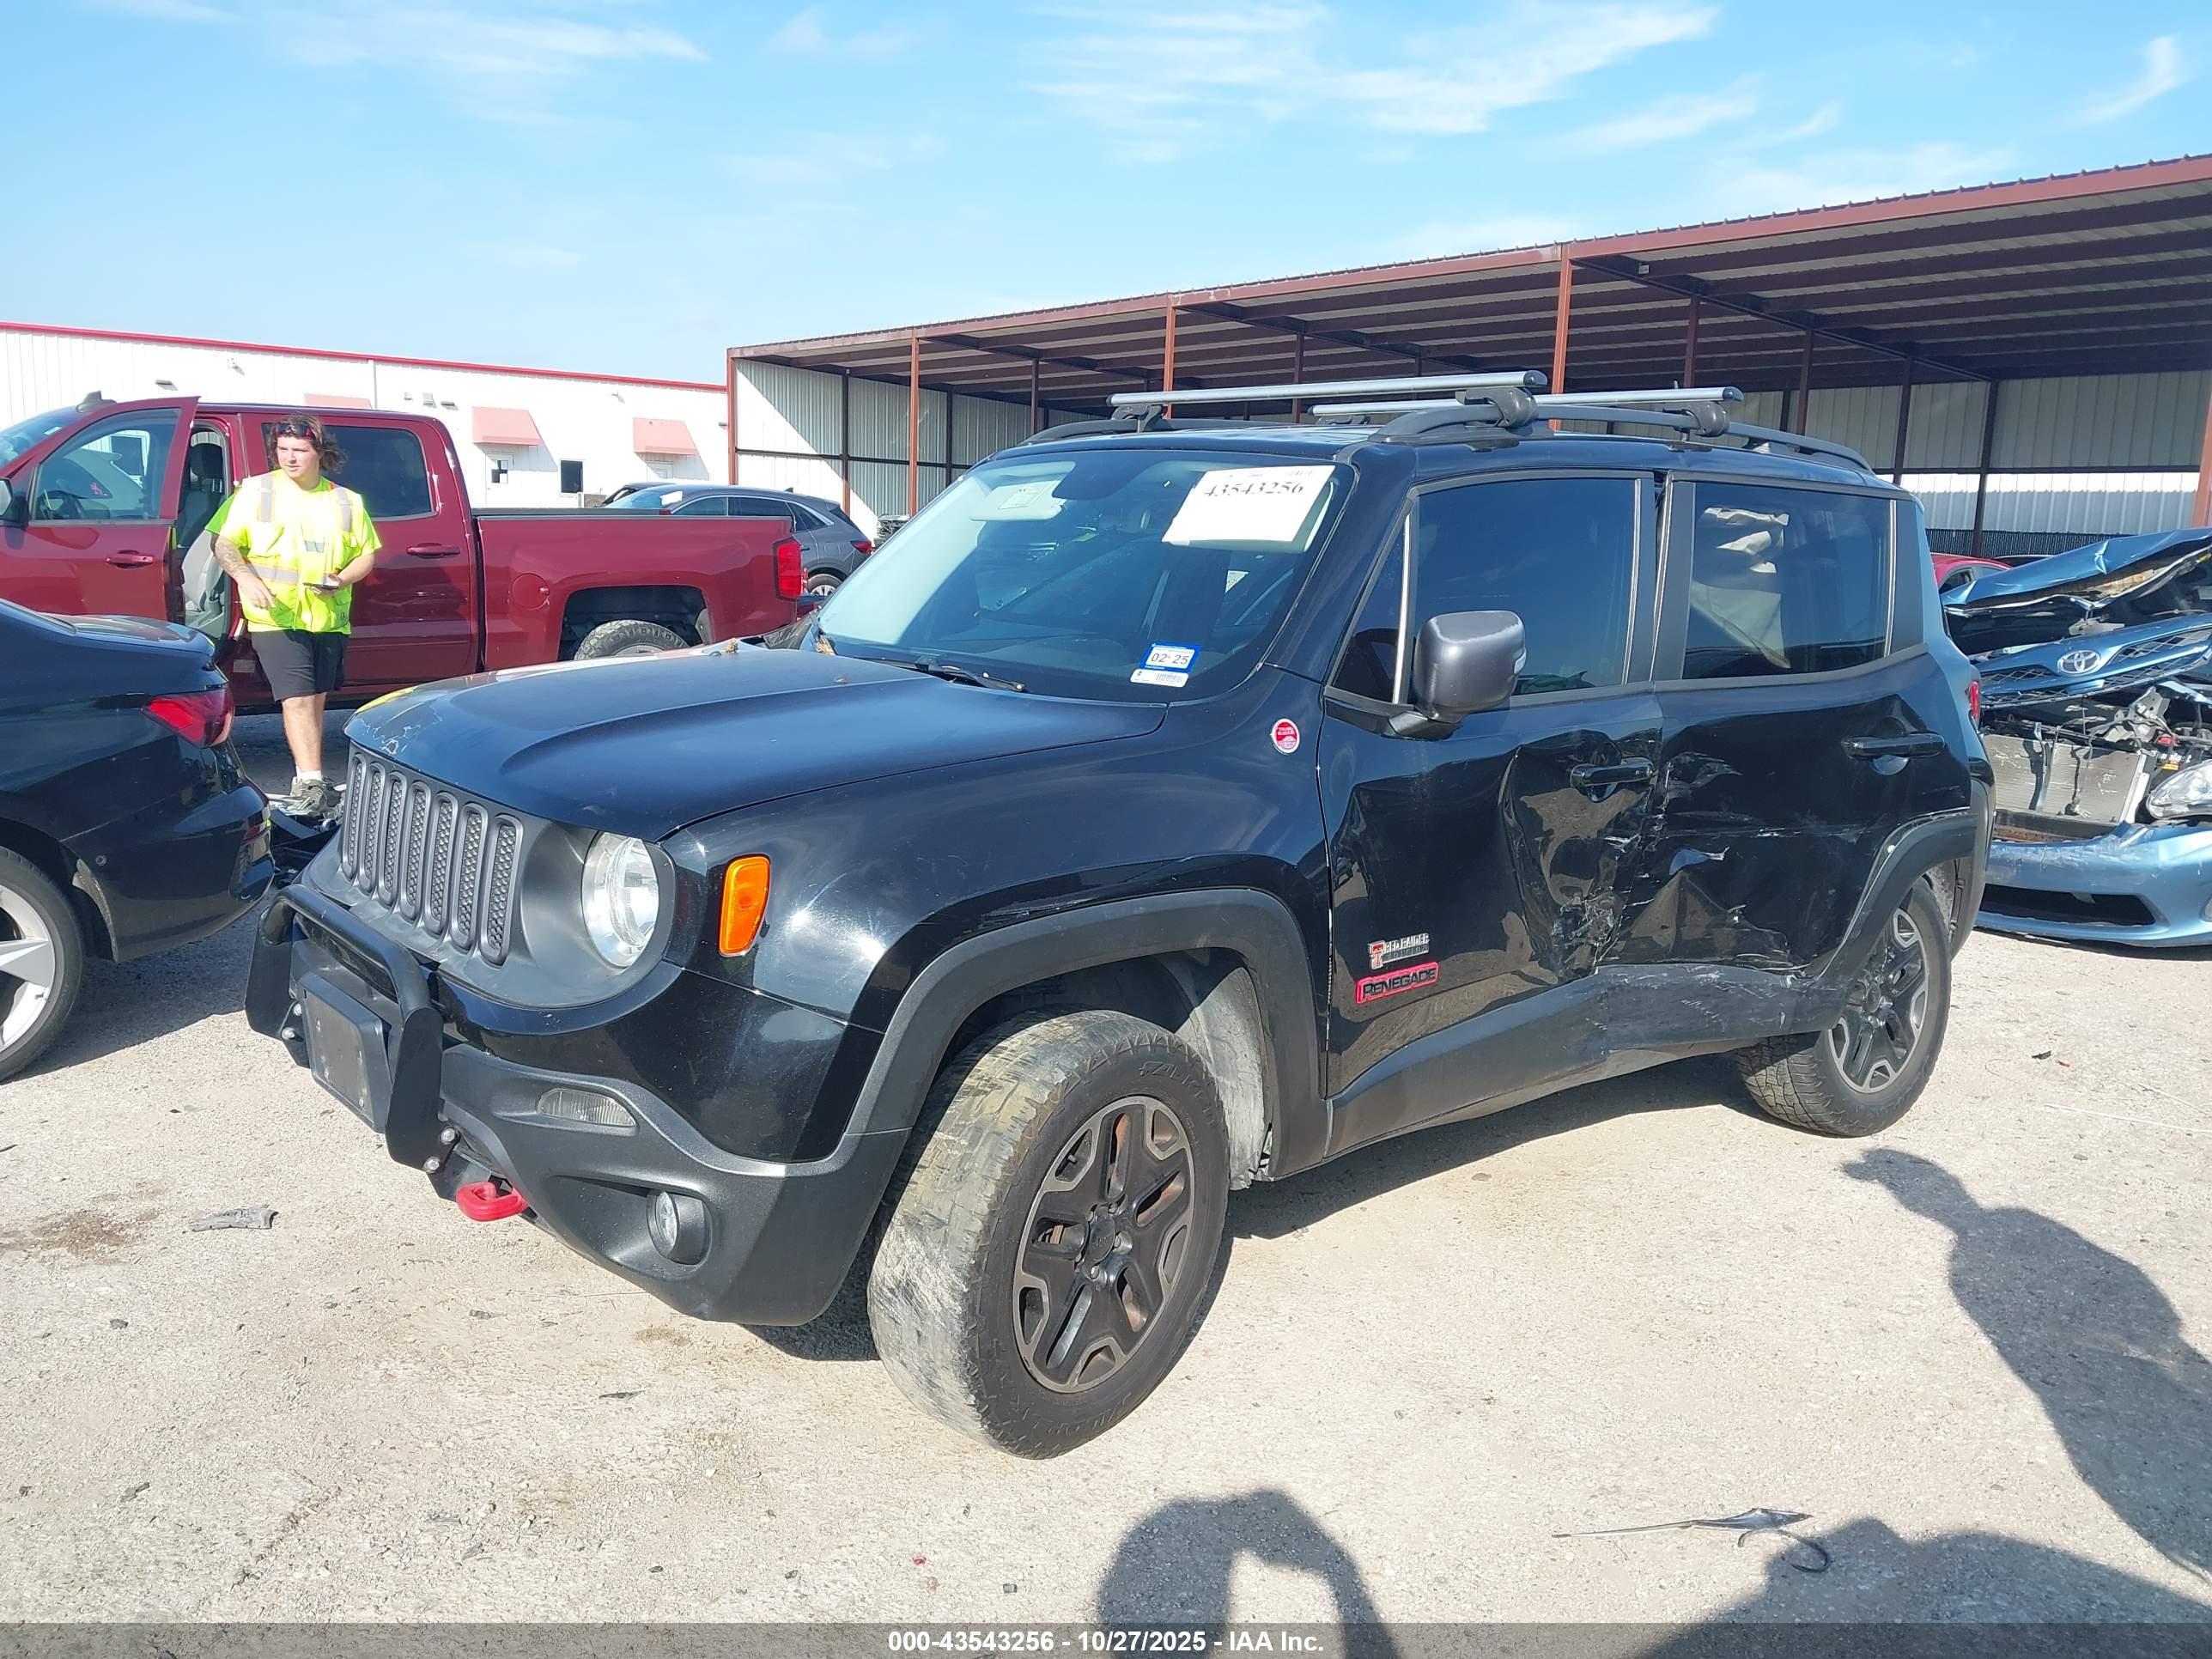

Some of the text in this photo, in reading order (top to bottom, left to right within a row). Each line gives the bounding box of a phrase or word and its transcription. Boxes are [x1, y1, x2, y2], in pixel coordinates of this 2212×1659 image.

[1205, 481, 1304, 497] 43543256
[1151, 653, 1190, 665] 02 25
[1363, 968, 1437, 1000] RENEGADE
